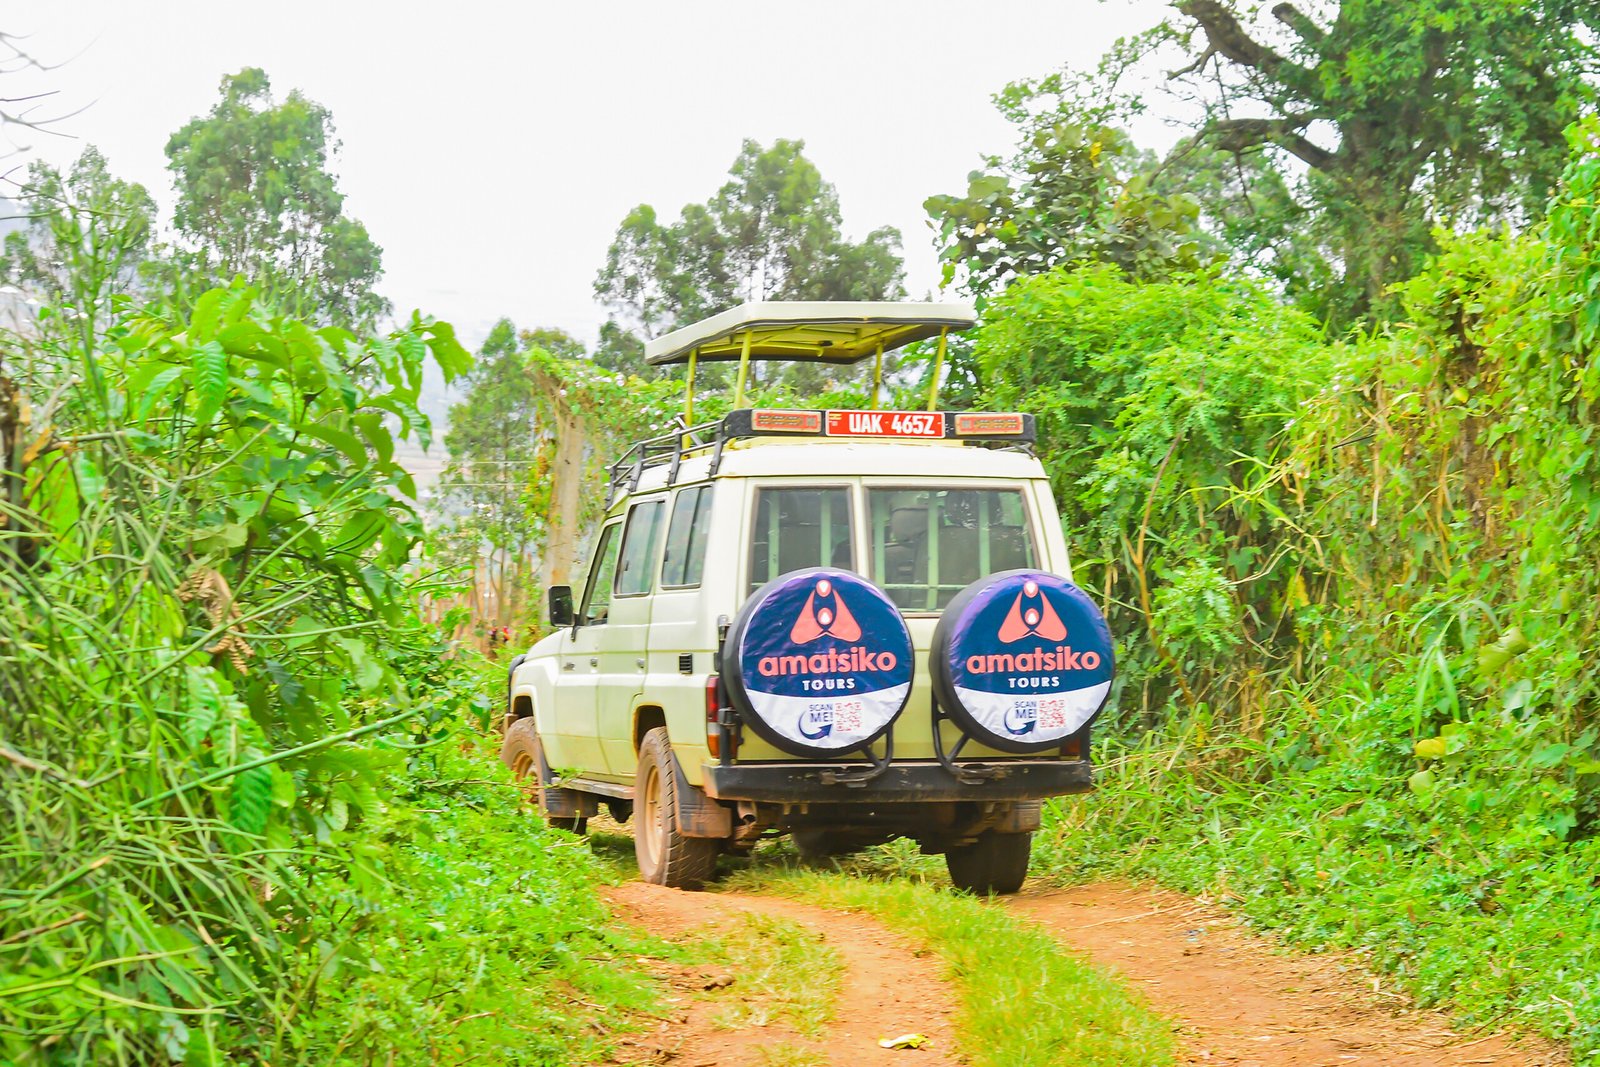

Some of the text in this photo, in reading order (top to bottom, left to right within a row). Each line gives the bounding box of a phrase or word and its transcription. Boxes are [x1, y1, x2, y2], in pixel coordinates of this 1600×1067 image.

[849, 413, 935, 435] UAK 465Z
[758, 646, 897, 677] amatsiko
[966, 646, 1101, 675] amatsiko
[802, 678, 855, 691] TOURS
[1008, 676, 1060, 688] TOURS
[808, 703, 833, 712] SCAN
[1014, 701, 1037, 709] SCAN
[809, 712, 833, 723] ME!
[1015, 709, 1037, 719] ME!
